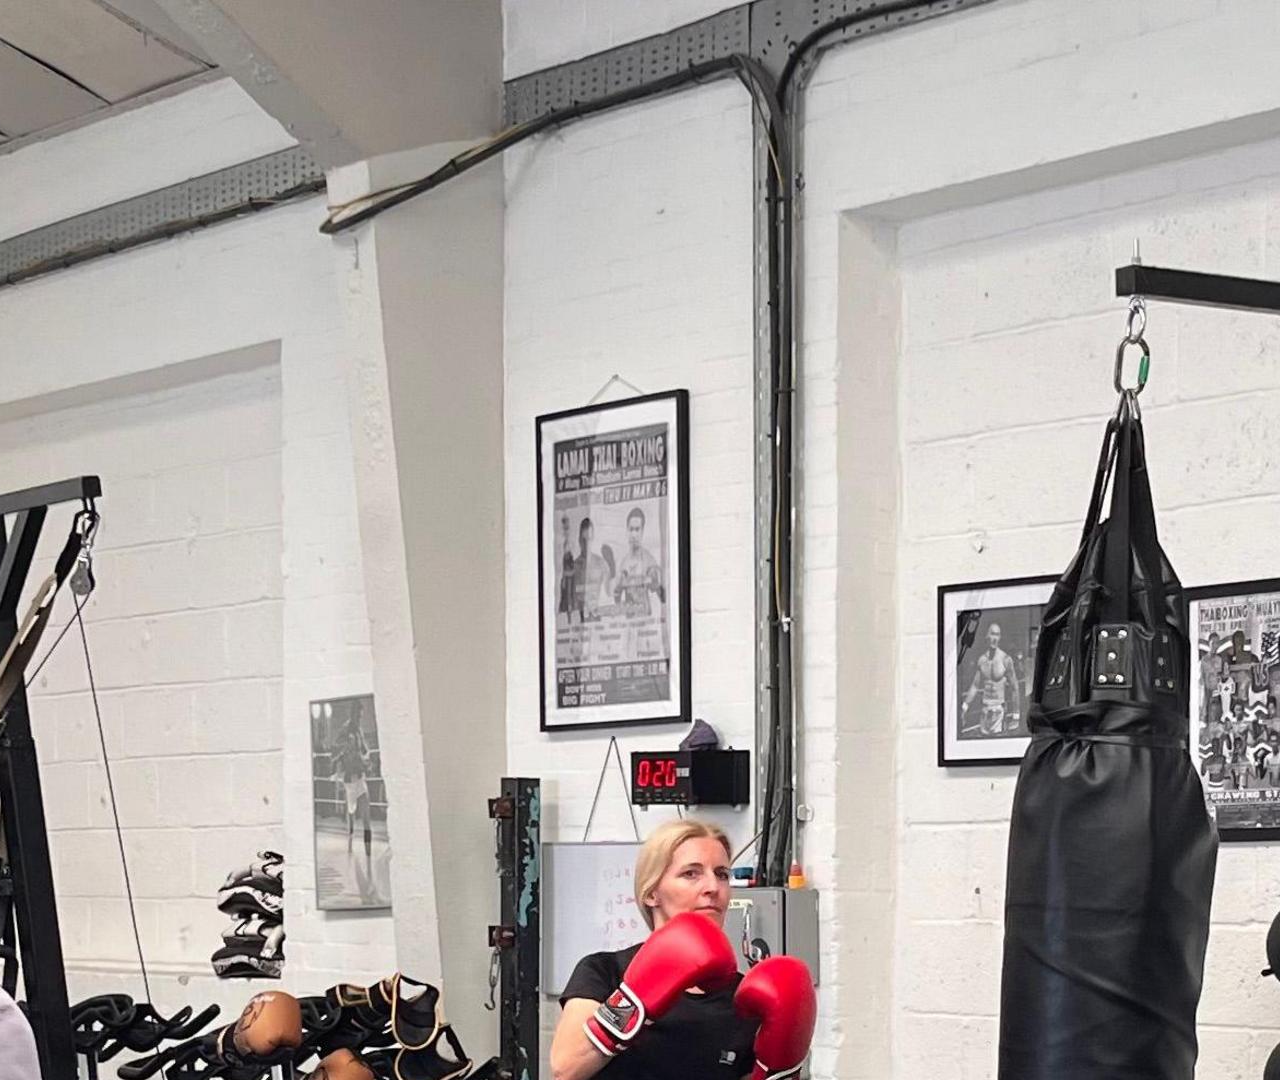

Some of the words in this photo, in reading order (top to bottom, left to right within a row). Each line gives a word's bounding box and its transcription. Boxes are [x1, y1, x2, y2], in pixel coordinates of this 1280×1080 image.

[557, 447, 589, 478] LAMAI
[592, 442, 617, 472] THAI
[621, 436, 664, 468] BOXING
[580, 692, 607, 704] FIGHT
